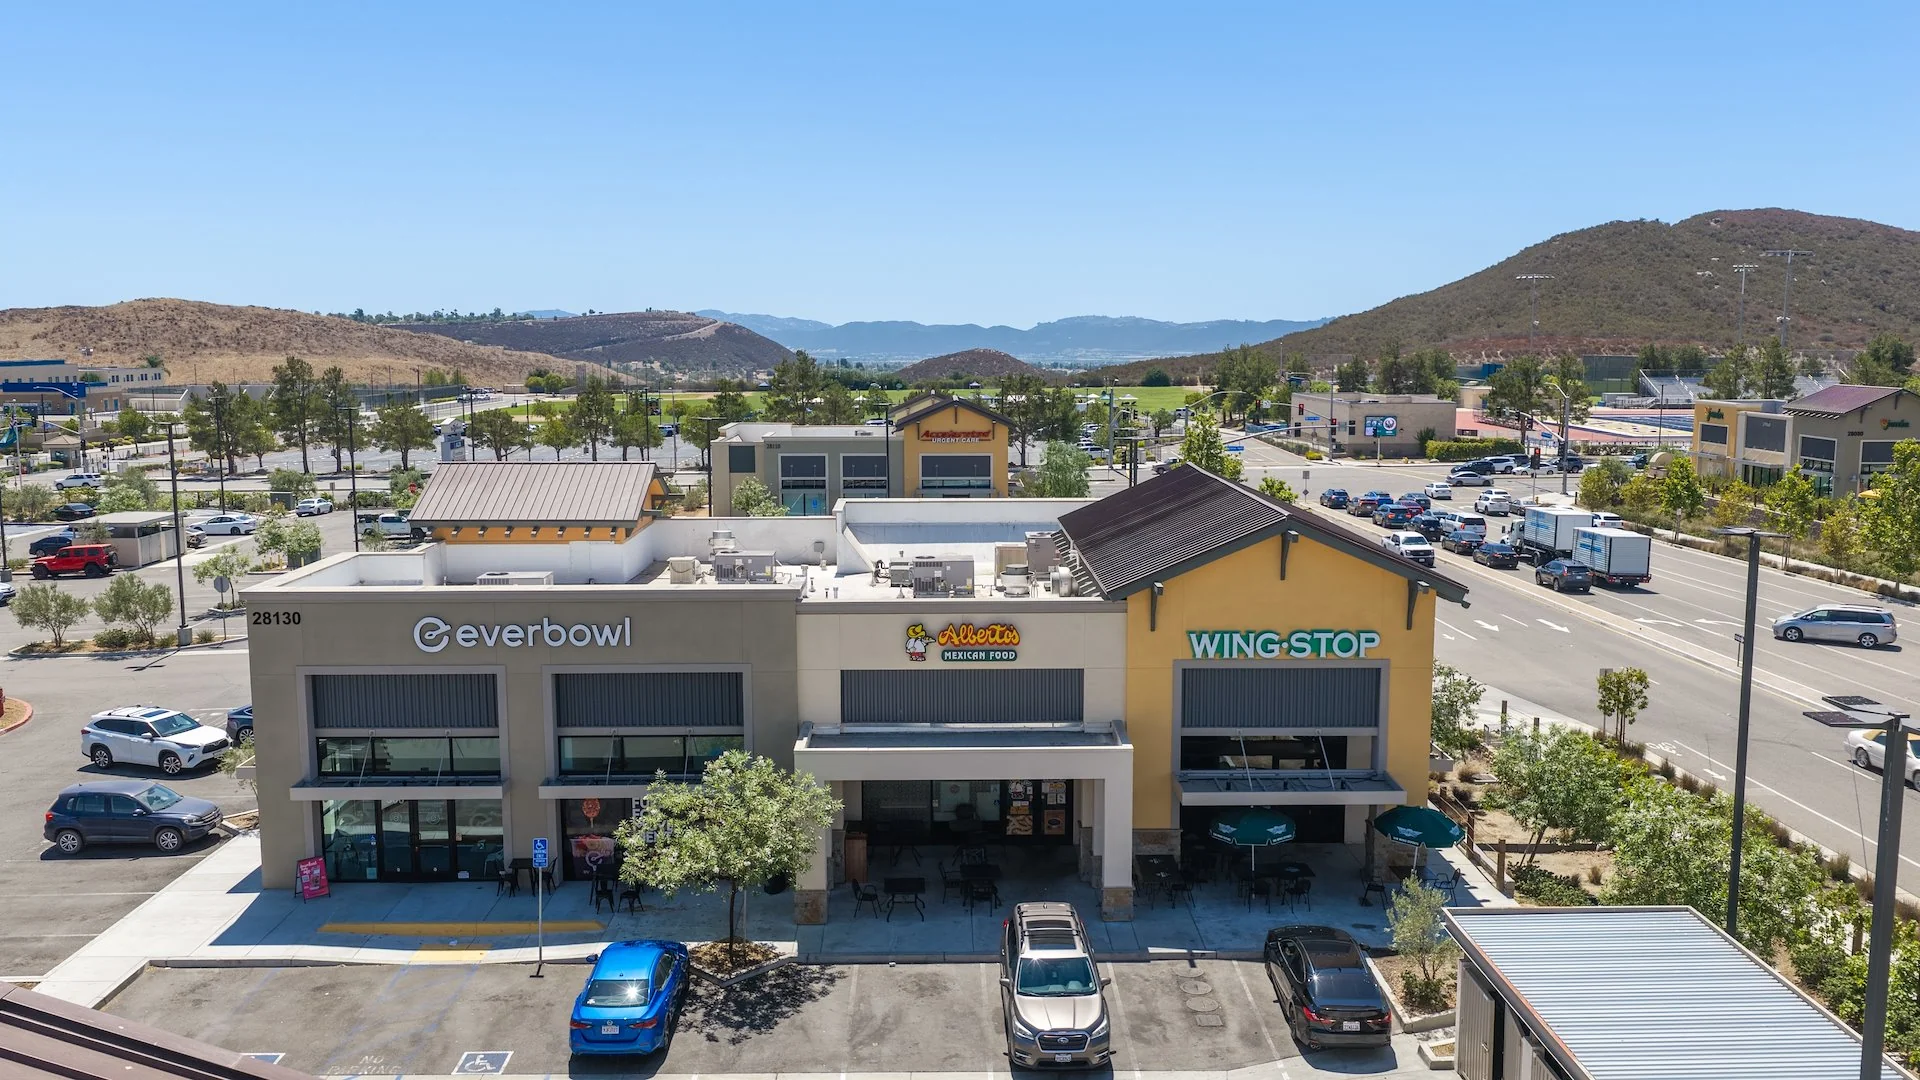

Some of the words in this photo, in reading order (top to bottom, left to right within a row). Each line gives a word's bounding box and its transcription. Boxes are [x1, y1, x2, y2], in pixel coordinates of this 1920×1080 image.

[921, 429, 991, 438] Accelerated
[252, 611, 301, 626] 28130
[456, 617, 632, 647] everbowl
[944, 651, 986, 660] MEXICAN
[990, 651, 1016, 660] FOOD
